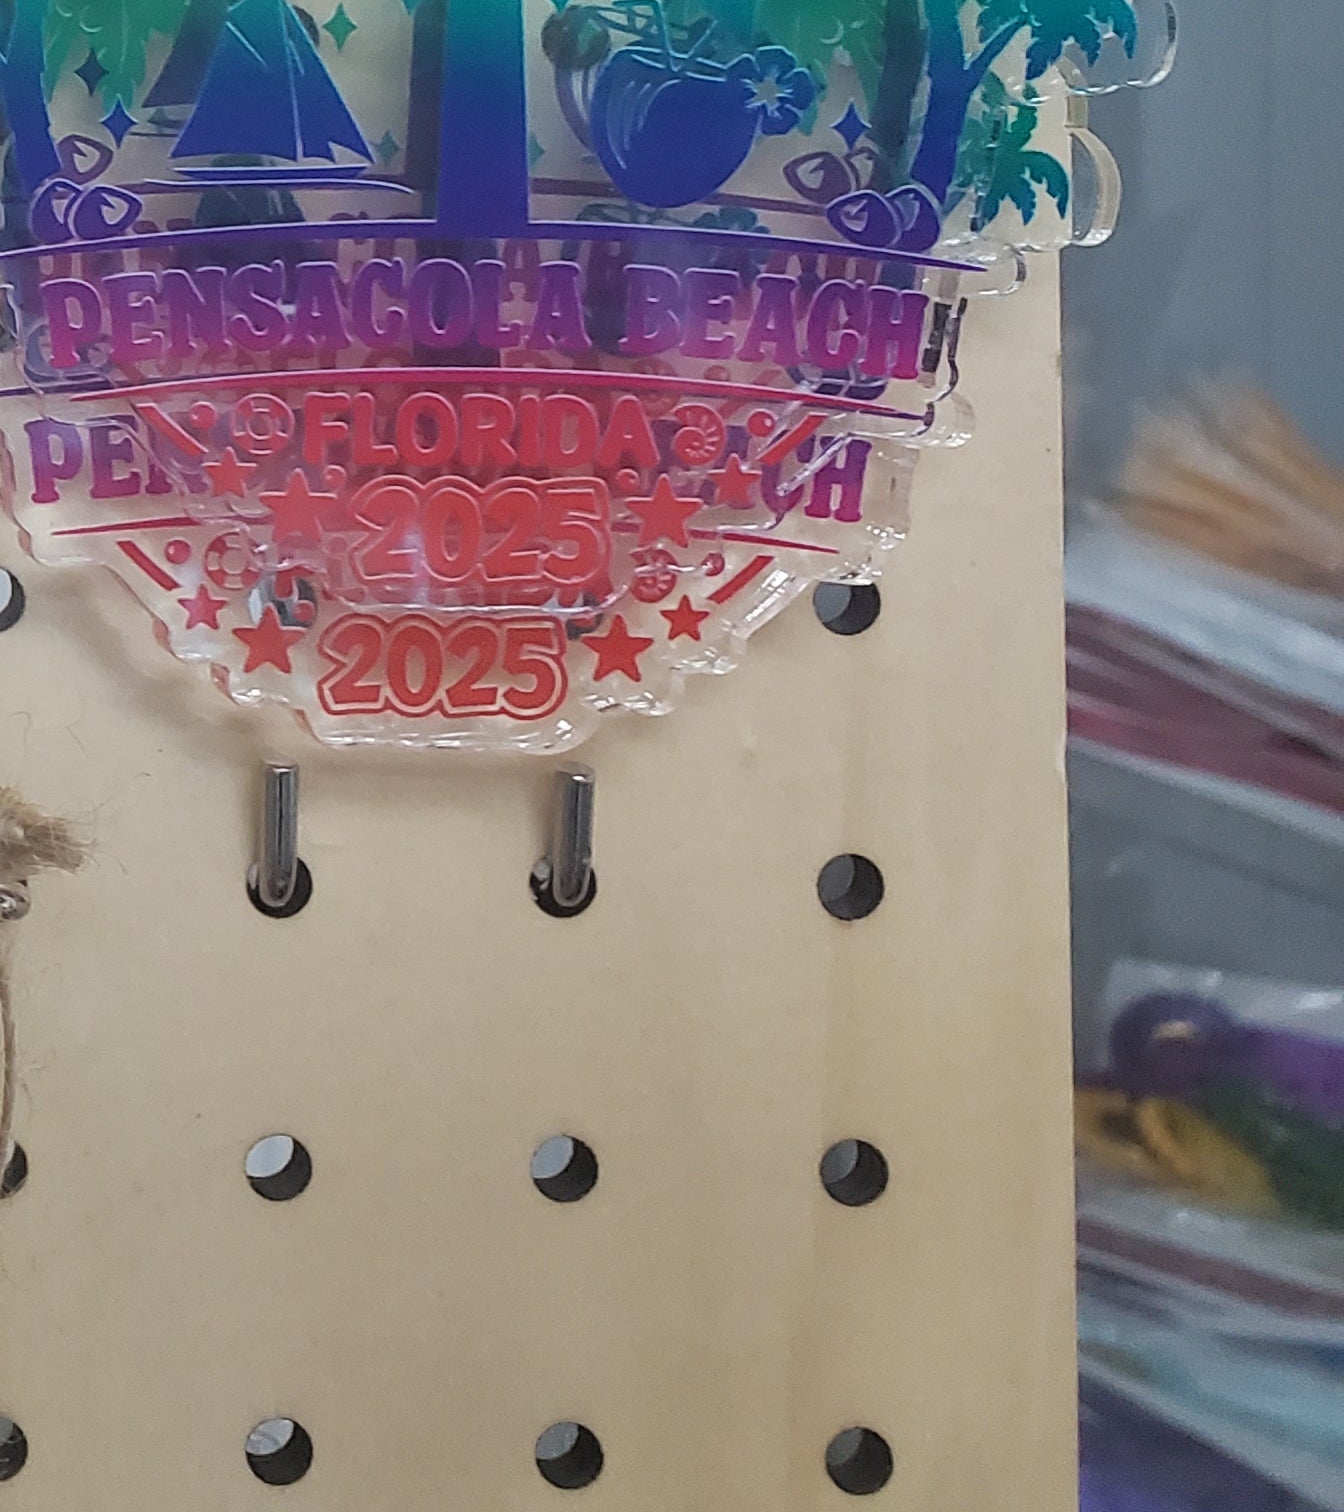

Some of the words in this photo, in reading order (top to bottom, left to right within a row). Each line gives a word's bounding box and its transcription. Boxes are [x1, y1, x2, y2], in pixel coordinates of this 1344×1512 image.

[38, 257, 593, 370] PENSACOLA
[618, 262, 930, 380] BEACH
[302, 391, 661, 468] FLORIDA
[349, 477, 609, 584] 2025
[317, 614, 568, 719] 2025
